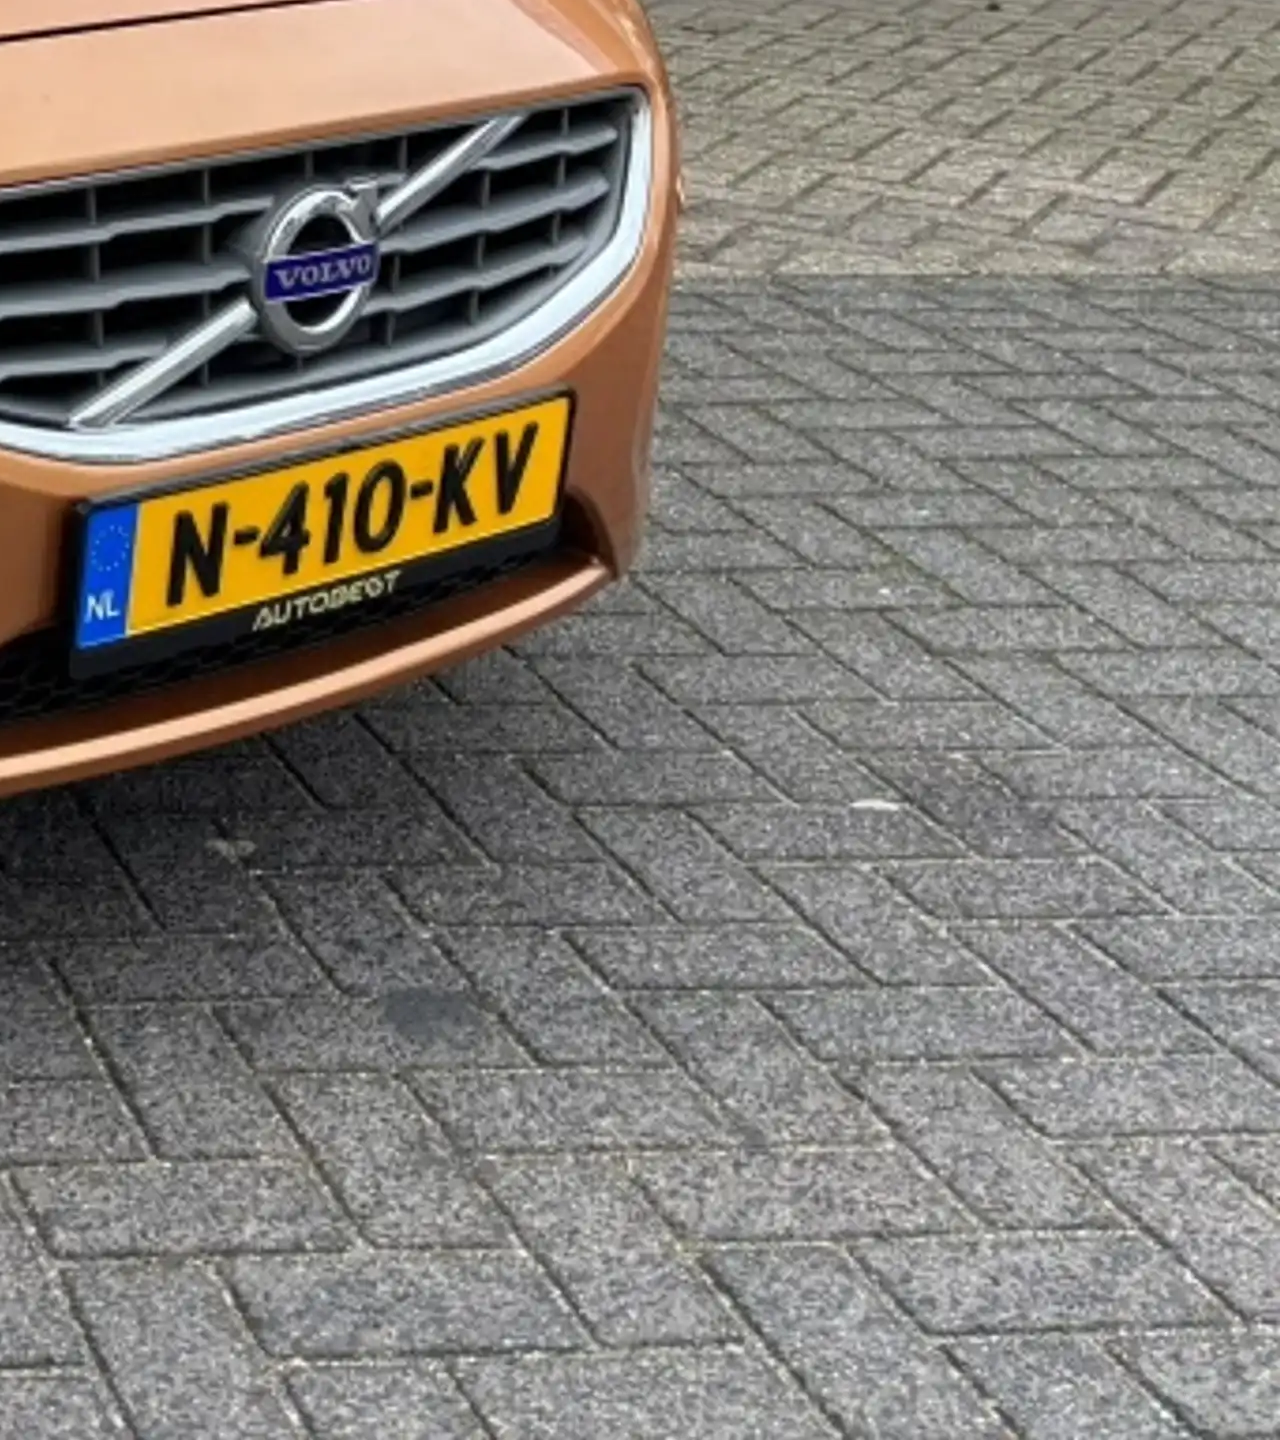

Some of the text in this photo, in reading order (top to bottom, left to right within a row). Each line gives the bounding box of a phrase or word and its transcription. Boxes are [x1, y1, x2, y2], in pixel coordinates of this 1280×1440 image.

[273, 254, 371, 290] VOLVO
[166, 422, 538, 608] N-410-KV
[84, 588, 119, 623] NL
